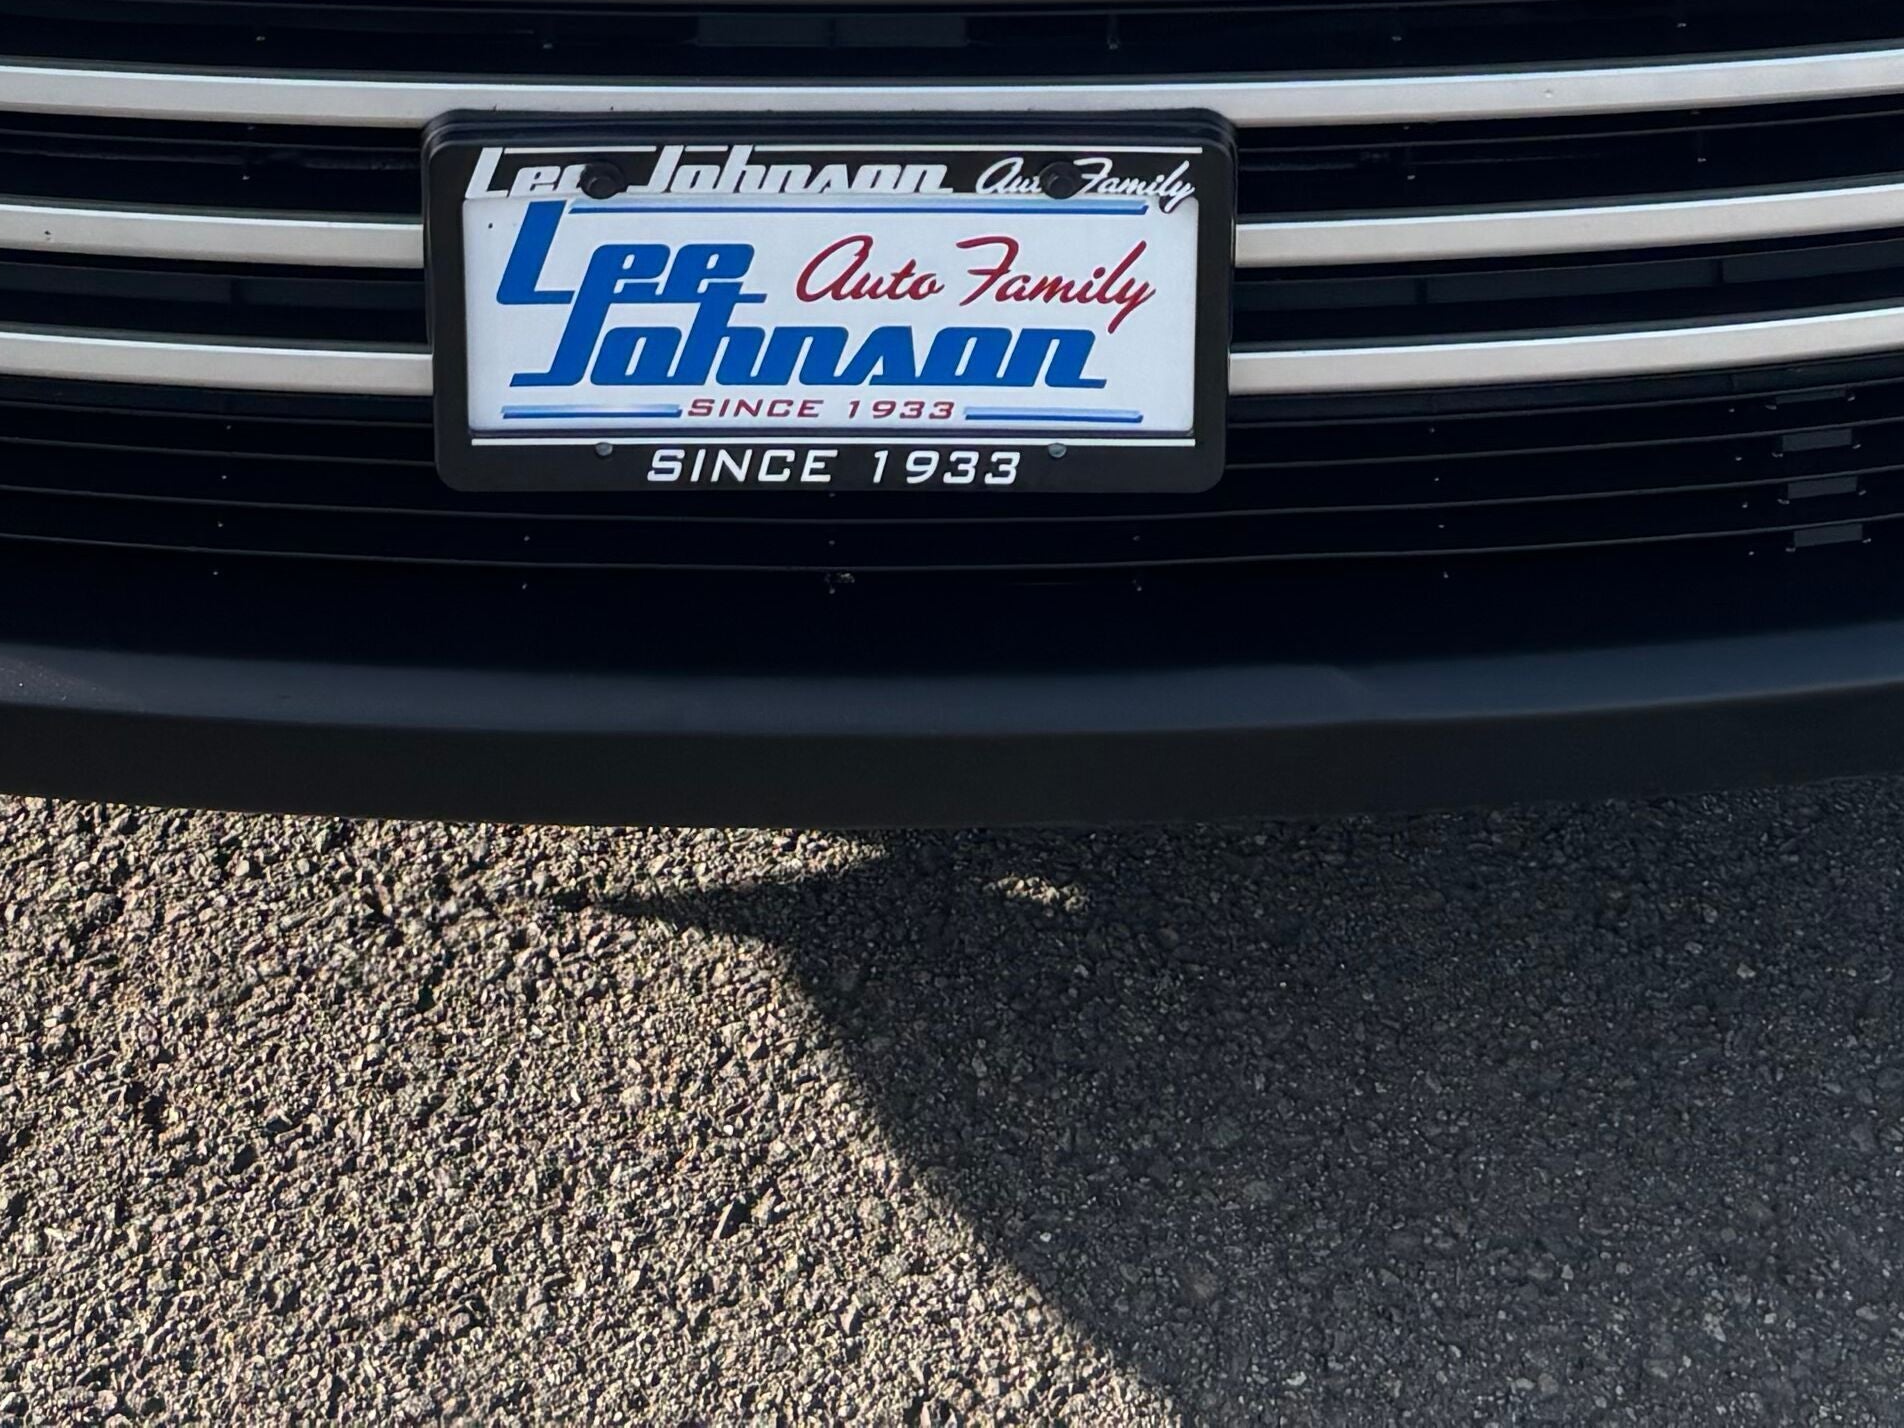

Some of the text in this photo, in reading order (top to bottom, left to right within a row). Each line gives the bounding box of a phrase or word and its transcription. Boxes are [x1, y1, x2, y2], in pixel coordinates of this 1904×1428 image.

[626, 144, 954, 194] Johnson
[976, 156, 1049, 194] Au
[1072, 156, 1197, 214] Family
[496, 200, 1156, 334] Lee Auto Family
[510, 282, 1108, 389] Johnson
[687, 398, 957, 421] SINCE 1933
[646, 448, 1022, 486] SINCE 1933
